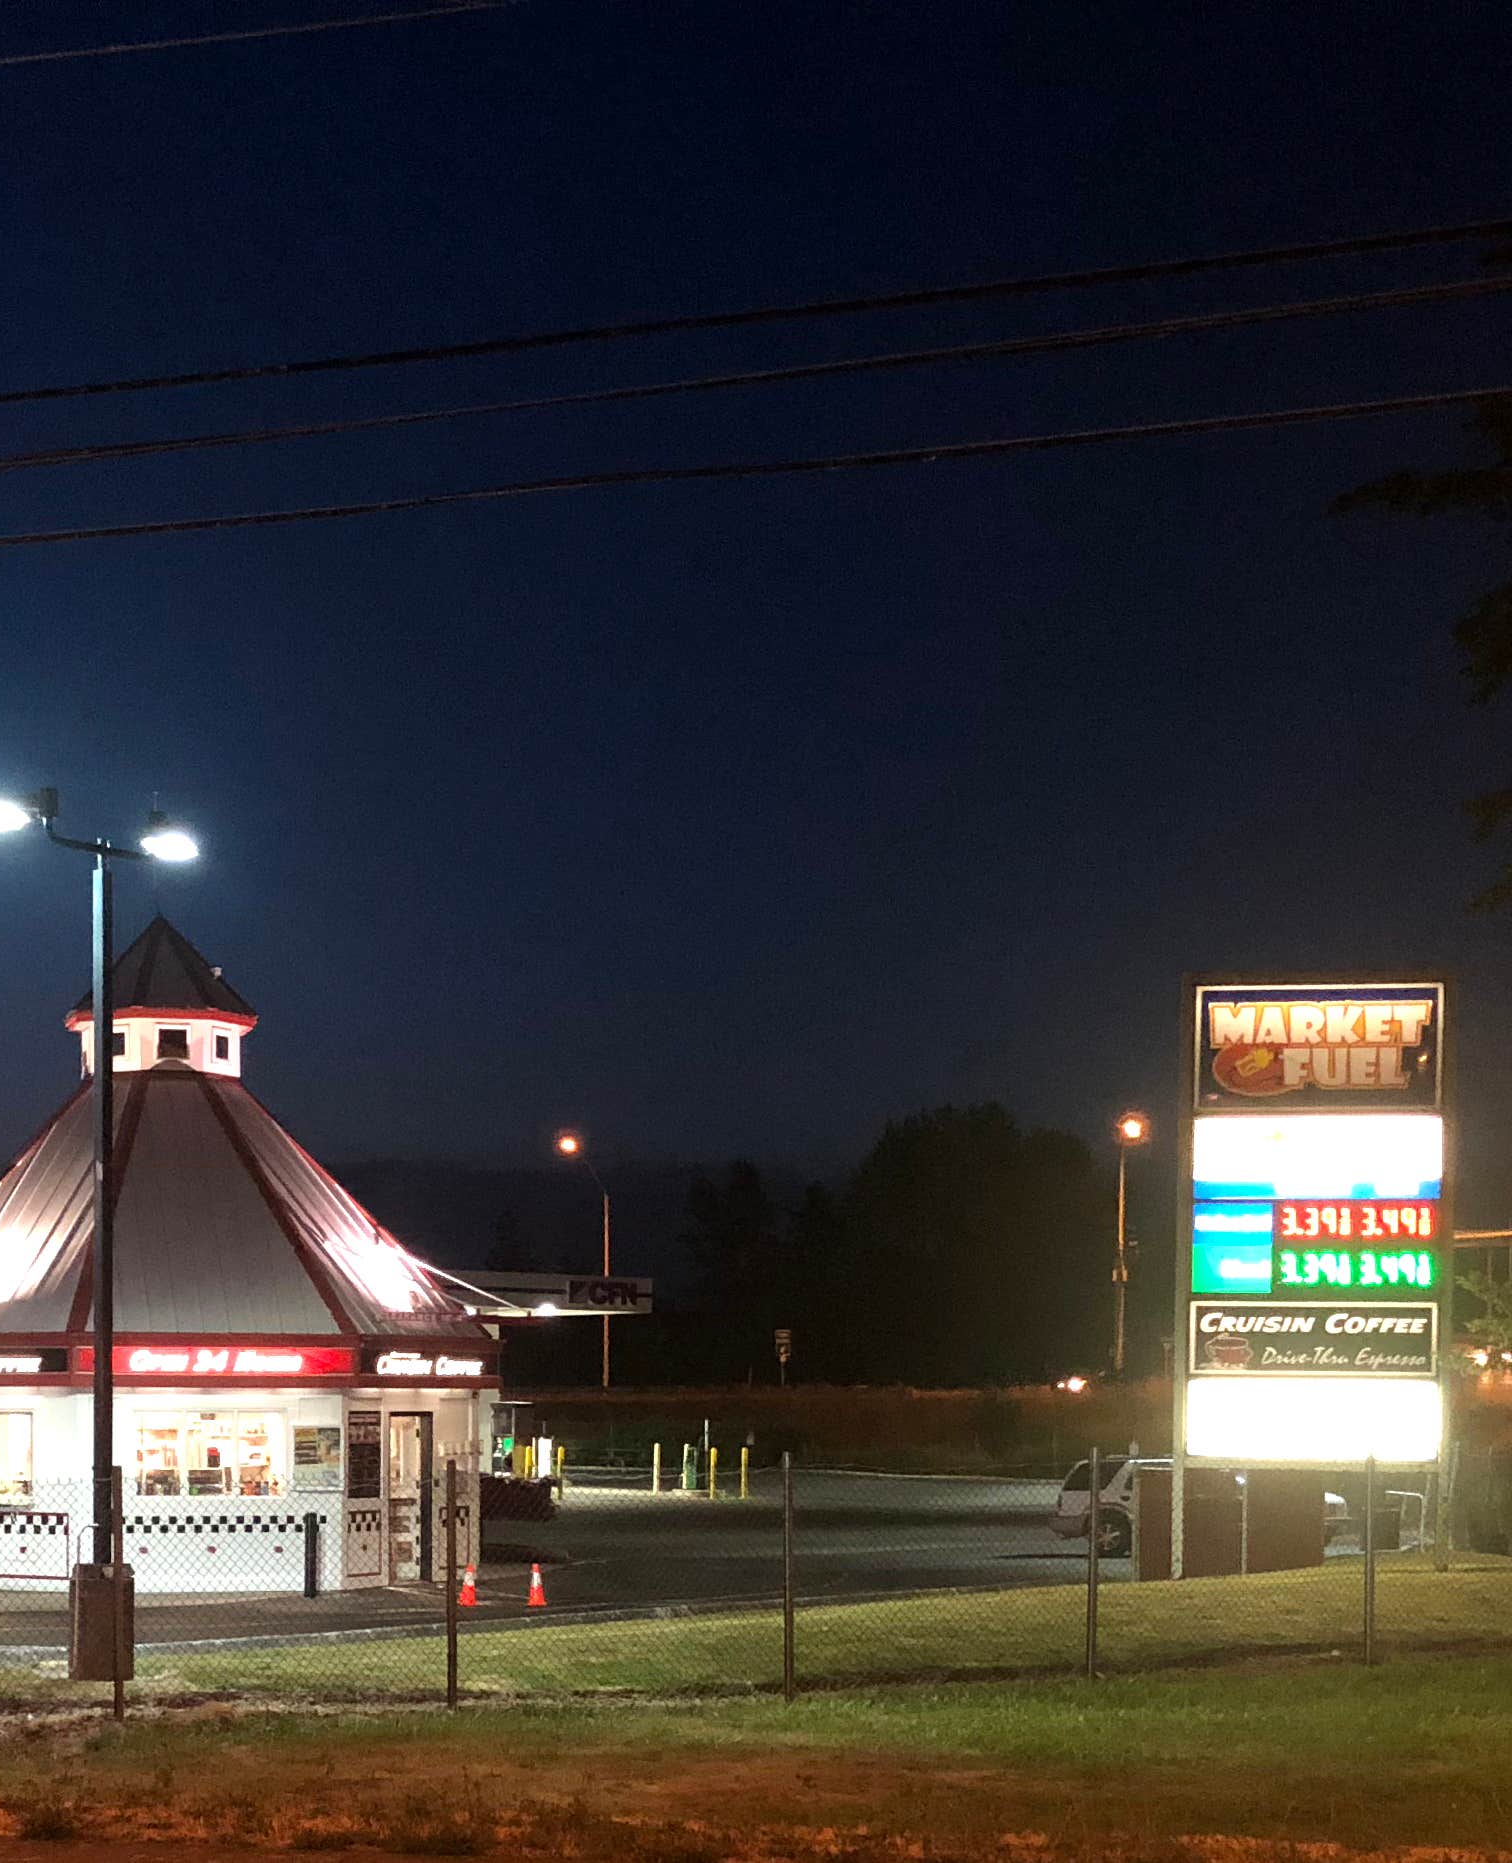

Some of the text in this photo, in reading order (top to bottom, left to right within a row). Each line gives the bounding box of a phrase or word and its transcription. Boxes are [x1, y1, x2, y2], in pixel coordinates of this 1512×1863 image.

[1209, 1000, 1433, 1047] MARKET
[1282, 1047, 1410, 1089] FUEL
[1199, 1312, 1428, 1334] CRUISIN COFFEE
[1261, 1347, 1426, 1370] Drive-Thru Espresso
